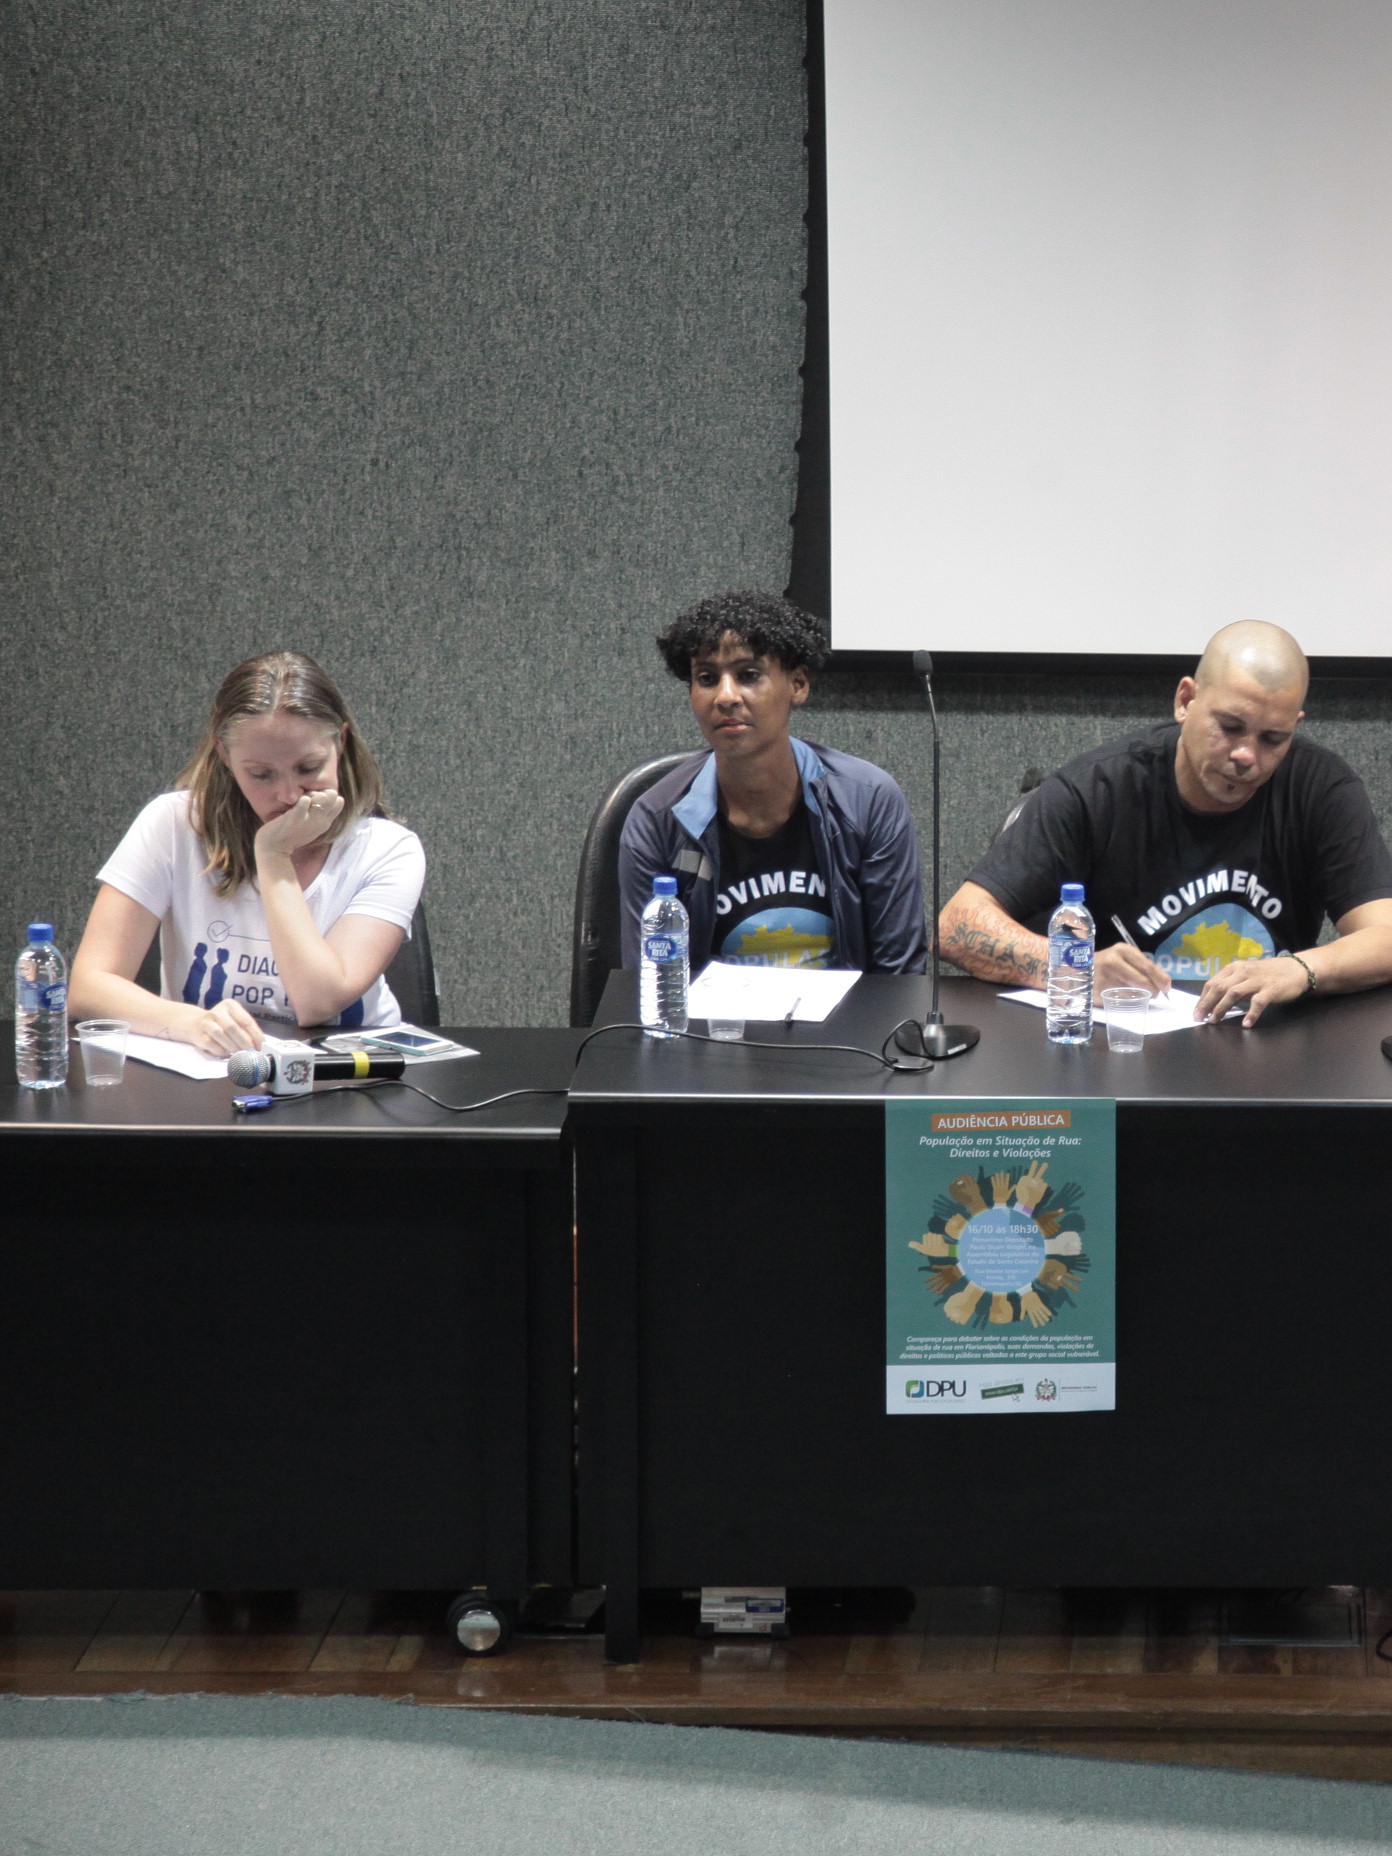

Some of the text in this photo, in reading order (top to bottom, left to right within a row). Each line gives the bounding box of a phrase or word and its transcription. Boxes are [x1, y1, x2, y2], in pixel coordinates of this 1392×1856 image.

[716, 870, 826, 915] OVIMEN
[1137, 869, 1283, 936] MOVIMENTO
[648, 941, 671, 950] SANTA
[652, 949, 668, 957] RITA
[1069, 948, 1090, 957] SANTA
[231, 984, 274, 1006] POP
[937, 1113, 1065, 1129] AUDIÊNCIA PÚBLICA
[919, 1136, 1082, 1148] População em Situação de Rua:
[950, 1148, 1051, 1160] Direitos e Violações
[968, 1225, 993, 1235] 16/10
[1009, 1225, 1039, 1234] 18h30
[927, 1380, 967, 1397] DPU
